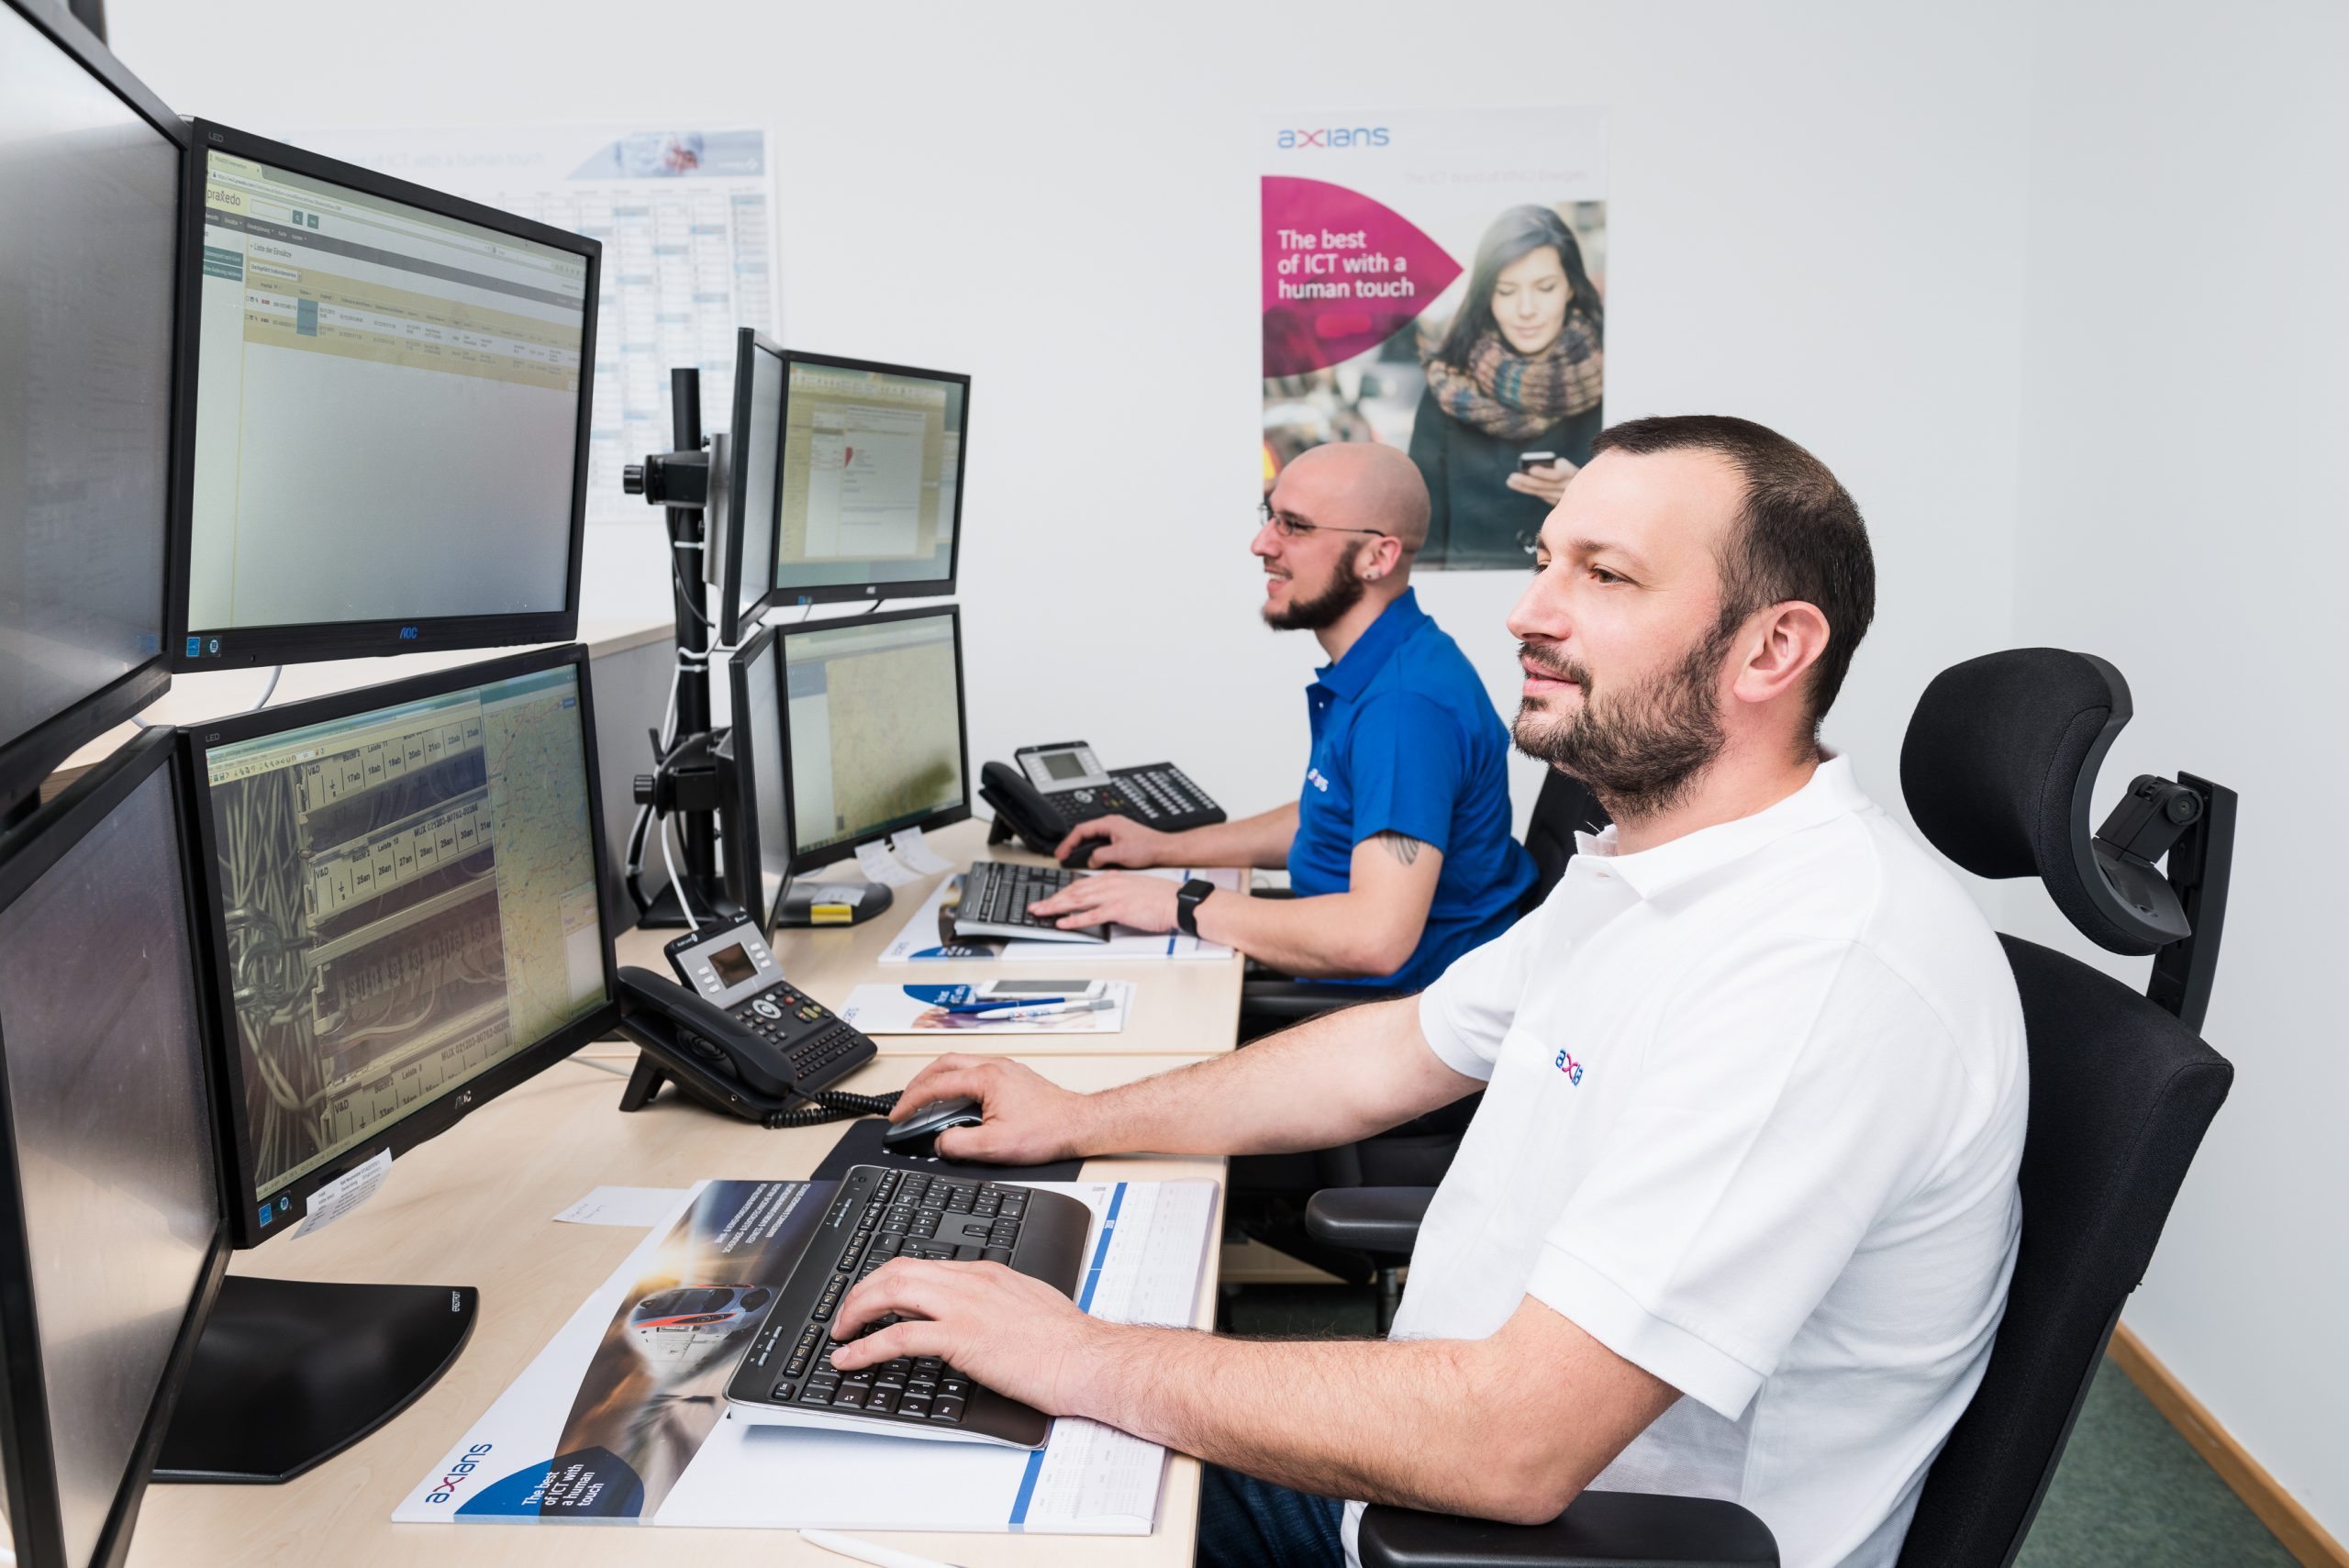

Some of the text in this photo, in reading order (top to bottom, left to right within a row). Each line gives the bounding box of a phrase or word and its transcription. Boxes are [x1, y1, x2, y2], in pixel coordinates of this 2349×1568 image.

[208, 132, 224, 144] LED
[1277, 128, 1390, 149] axians
[207, 187, 241, 206] praxedo
[1277, 229, 1366, 250] The best
[1277, 253, 1407, 274] of ICT with a
[1278, 278, 1414, 299] human touch
[399, 627, 417, 639] AOC
[206, 733, 220, 742] LED
[414, 825, 427, 837] MUX
[335, 1099, 349, 1114] V&D
[426, 1444, 493, 1504] axians
[521, 1472, 560, 1506] The best
[544, 1464, 584, 1506] of ICT with
[562, 1472, 596, 1498] human
[577, 1483, 605, 1507] touch
